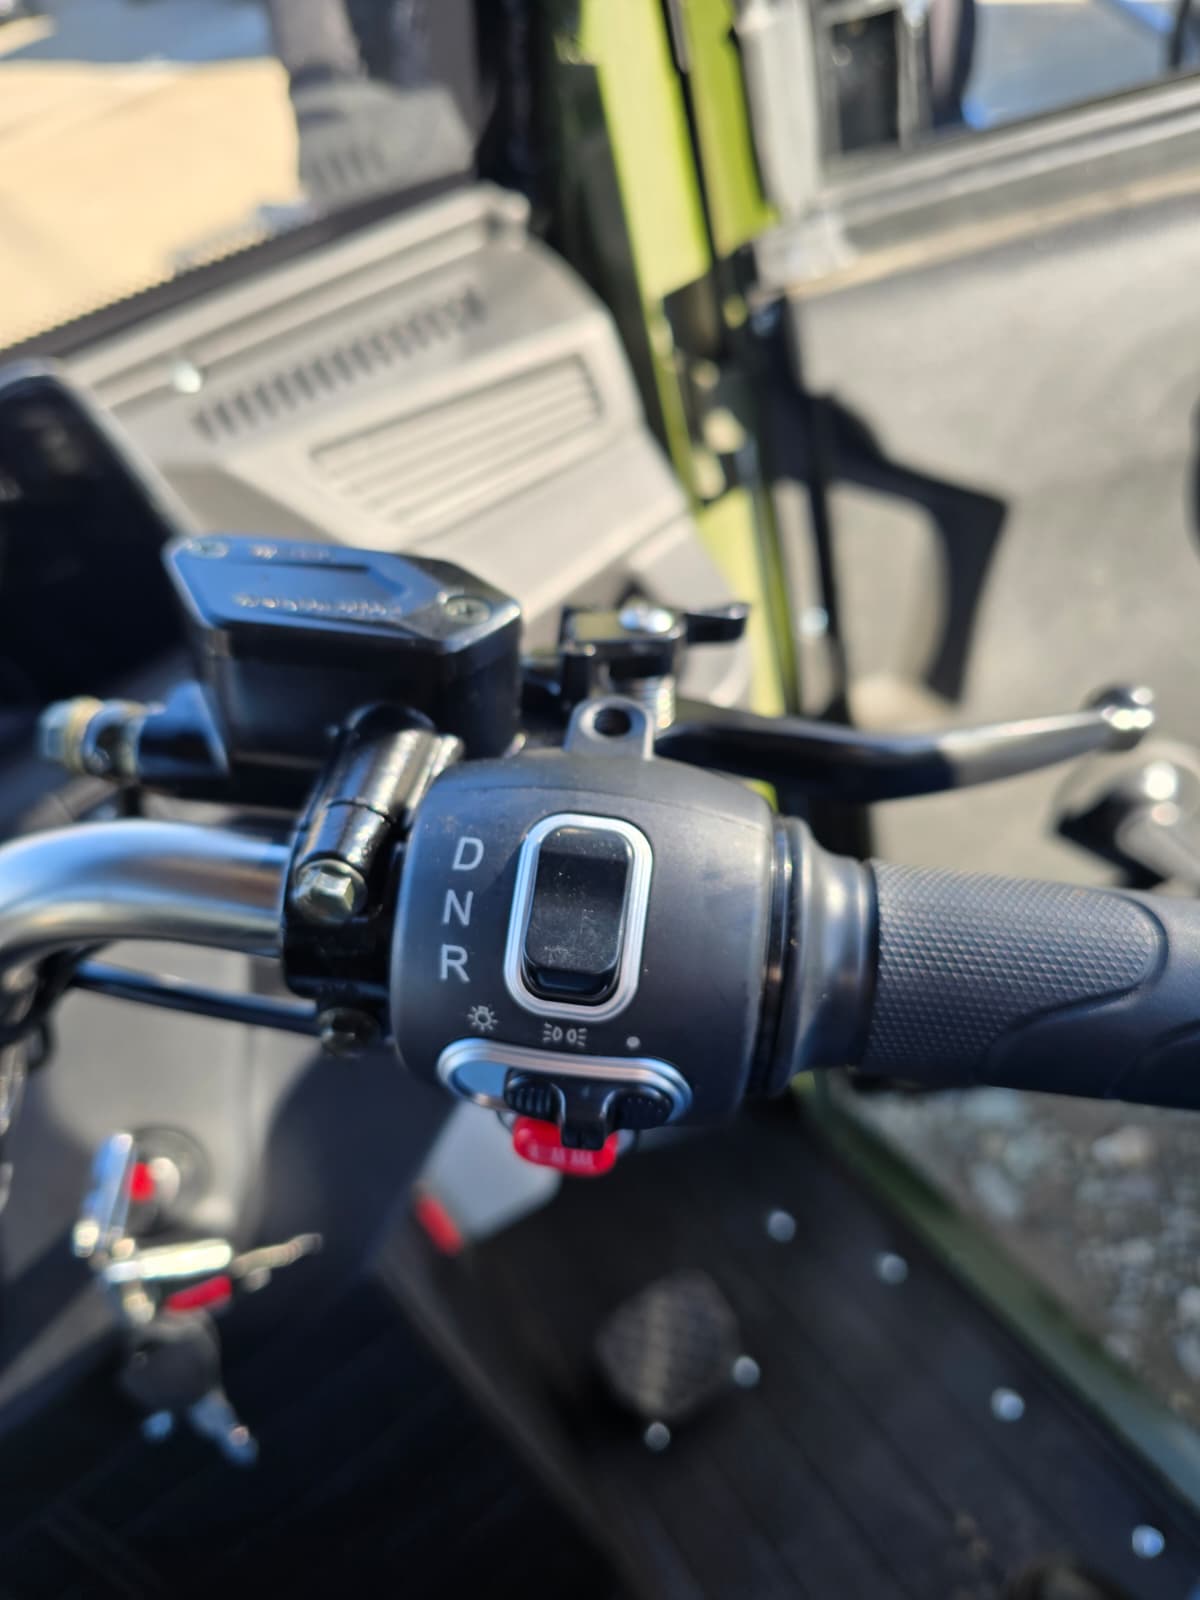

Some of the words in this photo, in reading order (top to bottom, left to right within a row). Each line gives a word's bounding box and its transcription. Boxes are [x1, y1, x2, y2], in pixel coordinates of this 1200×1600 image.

[452, 836, 484, 871] D
[442, 889, 474, 926] N
[440, 944, 470, 982] R
